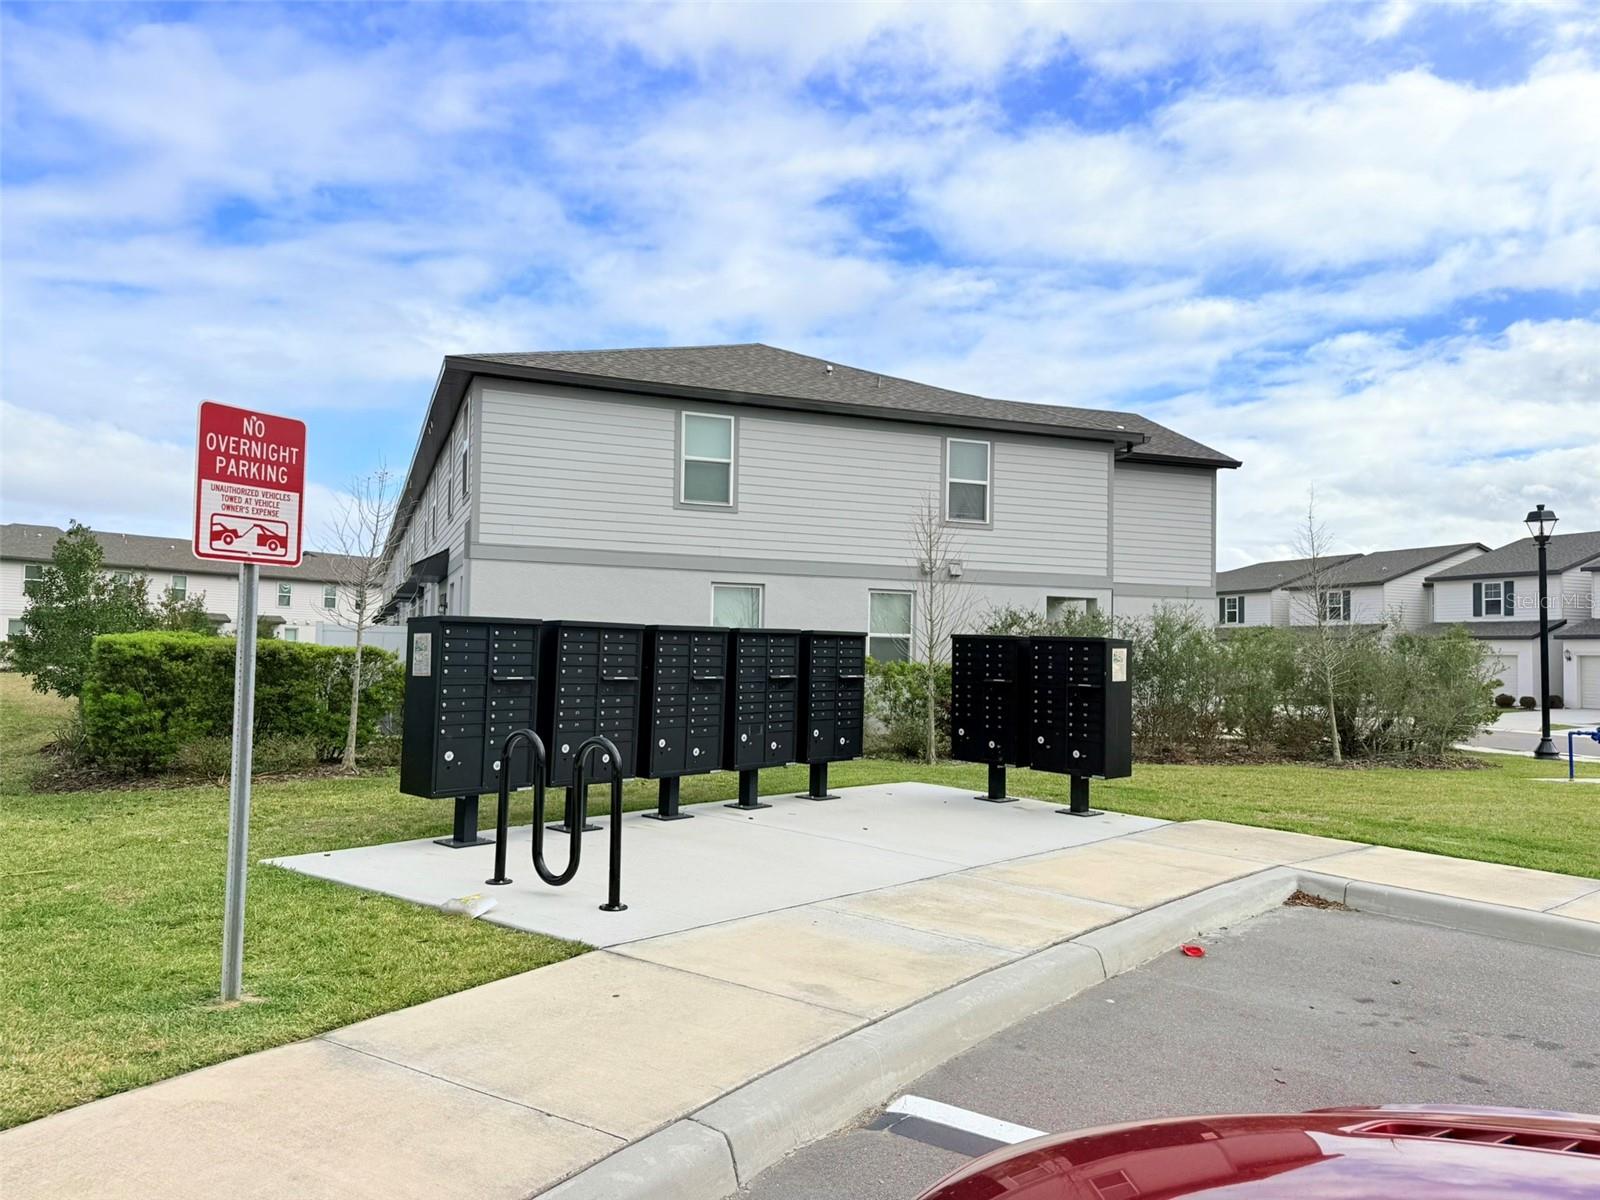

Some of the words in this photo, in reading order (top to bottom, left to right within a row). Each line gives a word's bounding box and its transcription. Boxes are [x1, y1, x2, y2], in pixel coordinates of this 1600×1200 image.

[243, 417, 265, 438] NO
[206, 433, 299, 465] OVERNIGHT
[216, 456, 288, 484] PARKING
[210, 483, 259, 497] UNAUTHORIZED
[221, 494, 243, 504] TOWED
[244, 497, 253, 505] AT
[254, 499, 280, 509] VEHICLE
[221, 504, 250, 514] OWNER'S
[251, 507, 280, 518] EXPENSE
